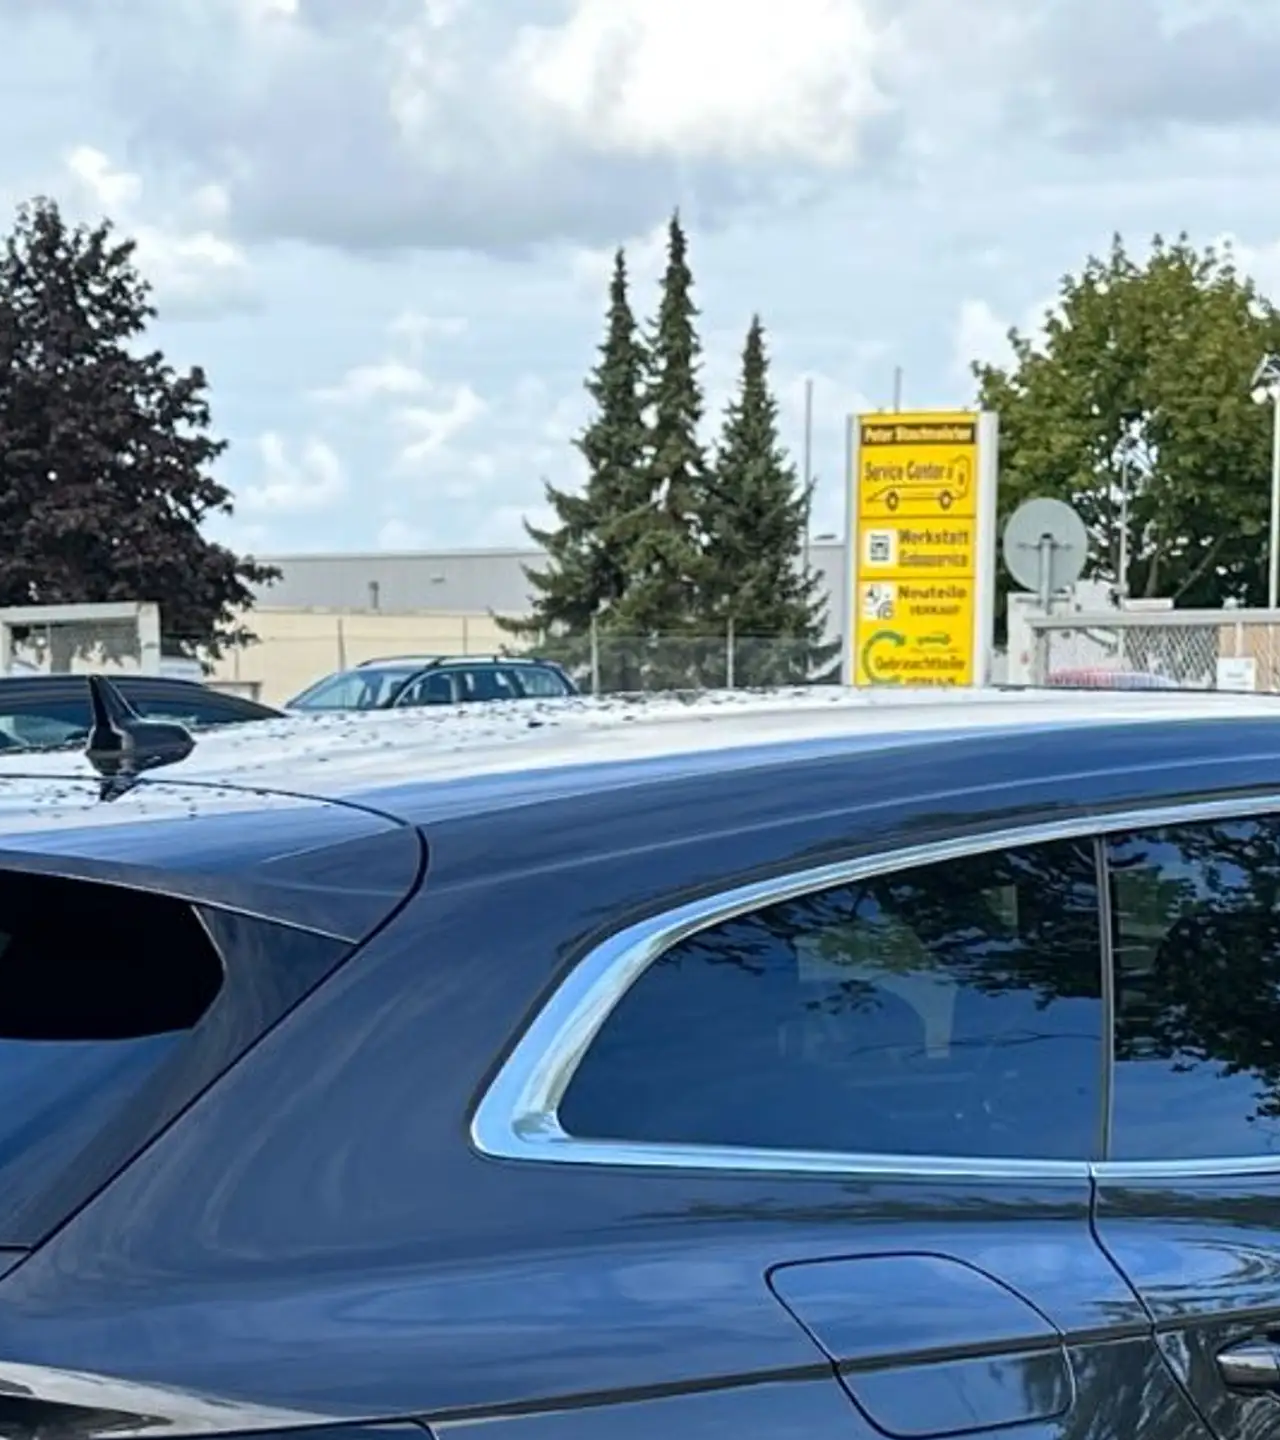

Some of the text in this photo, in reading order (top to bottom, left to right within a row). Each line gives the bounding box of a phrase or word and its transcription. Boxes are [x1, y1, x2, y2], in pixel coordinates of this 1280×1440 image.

[865, 460, 903, 482] Service
[897, 528, 969, 545] Werkstatt
[897, 585, 967, 599] Neuteile
